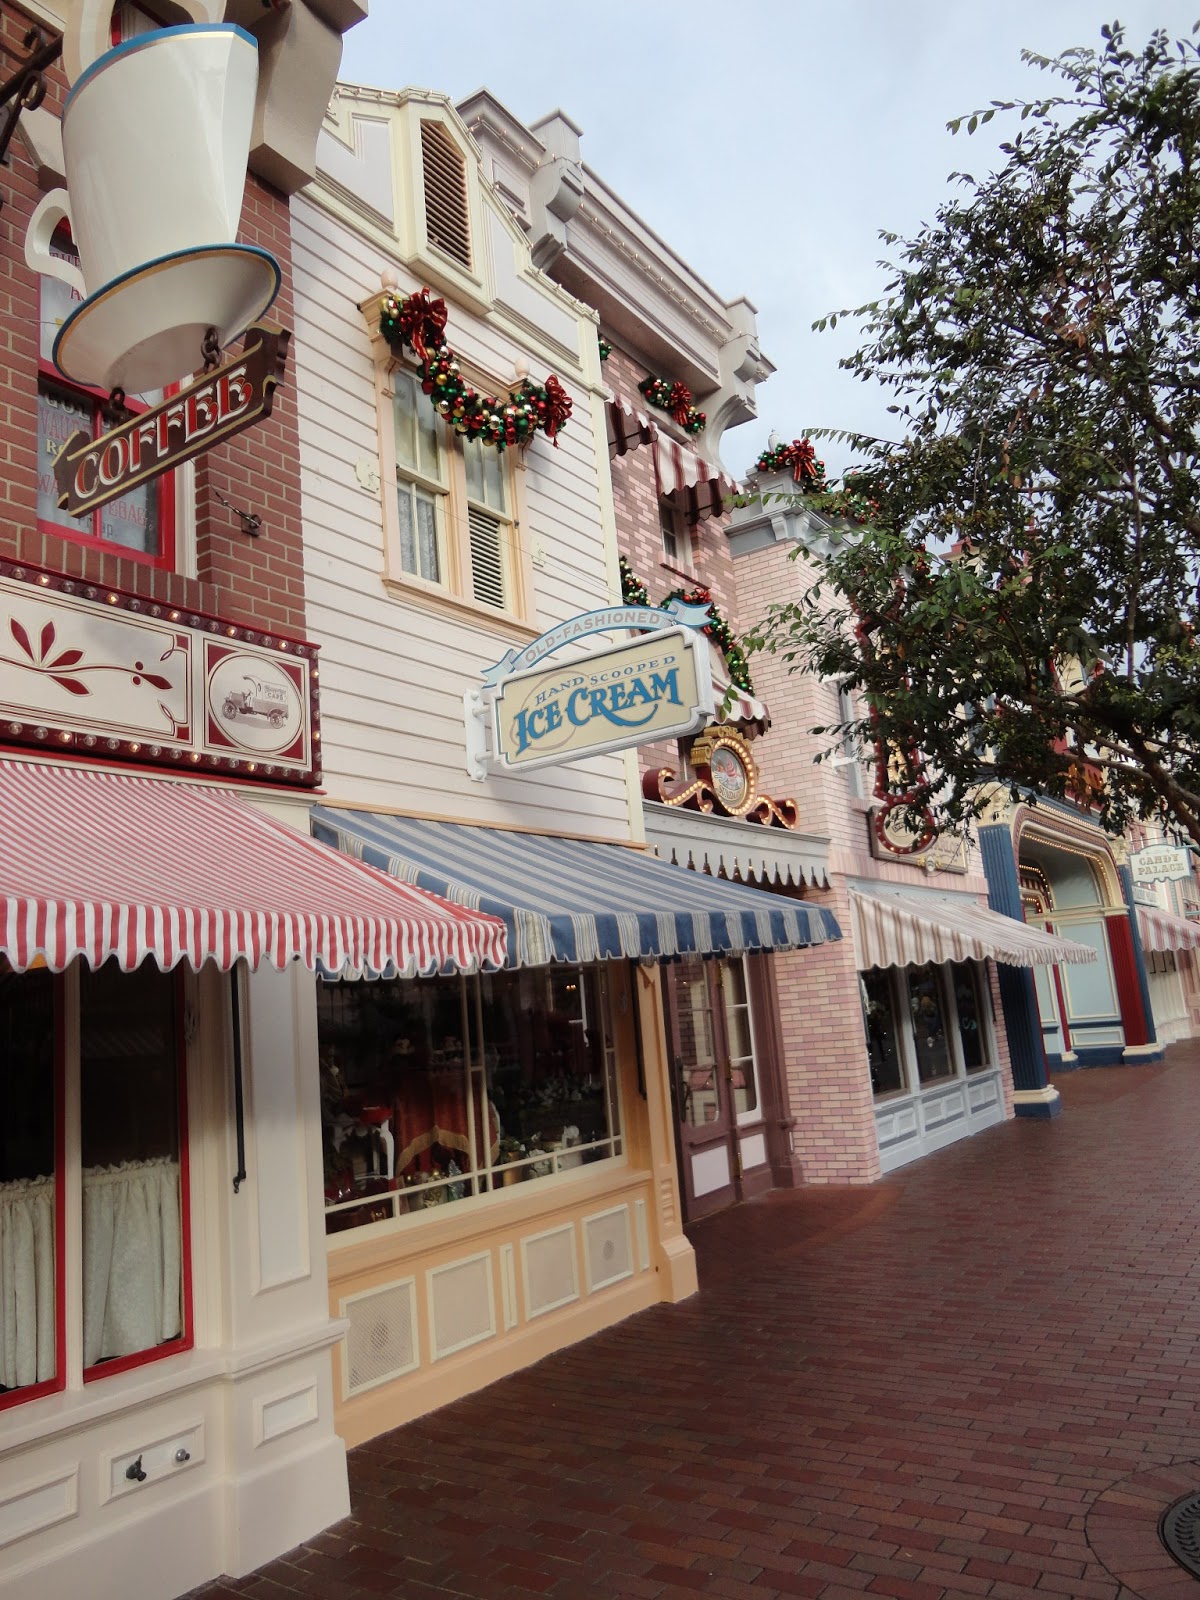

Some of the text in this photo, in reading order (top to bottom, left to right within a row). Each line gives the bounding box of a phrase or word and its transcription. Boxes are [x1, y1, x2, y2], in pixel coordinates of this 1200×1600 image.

[75, 364, 253, 499] COFFEE
[525, 611, 660, 663] OLD-FASHIONED
[535, 655, 676, 706] HAND SCOOPED
[514, 668, 684, 757] ICE CREAM
[1137, 863, 1185, 876] PALACE
[1138, 853, 1180, 866] CANDY
